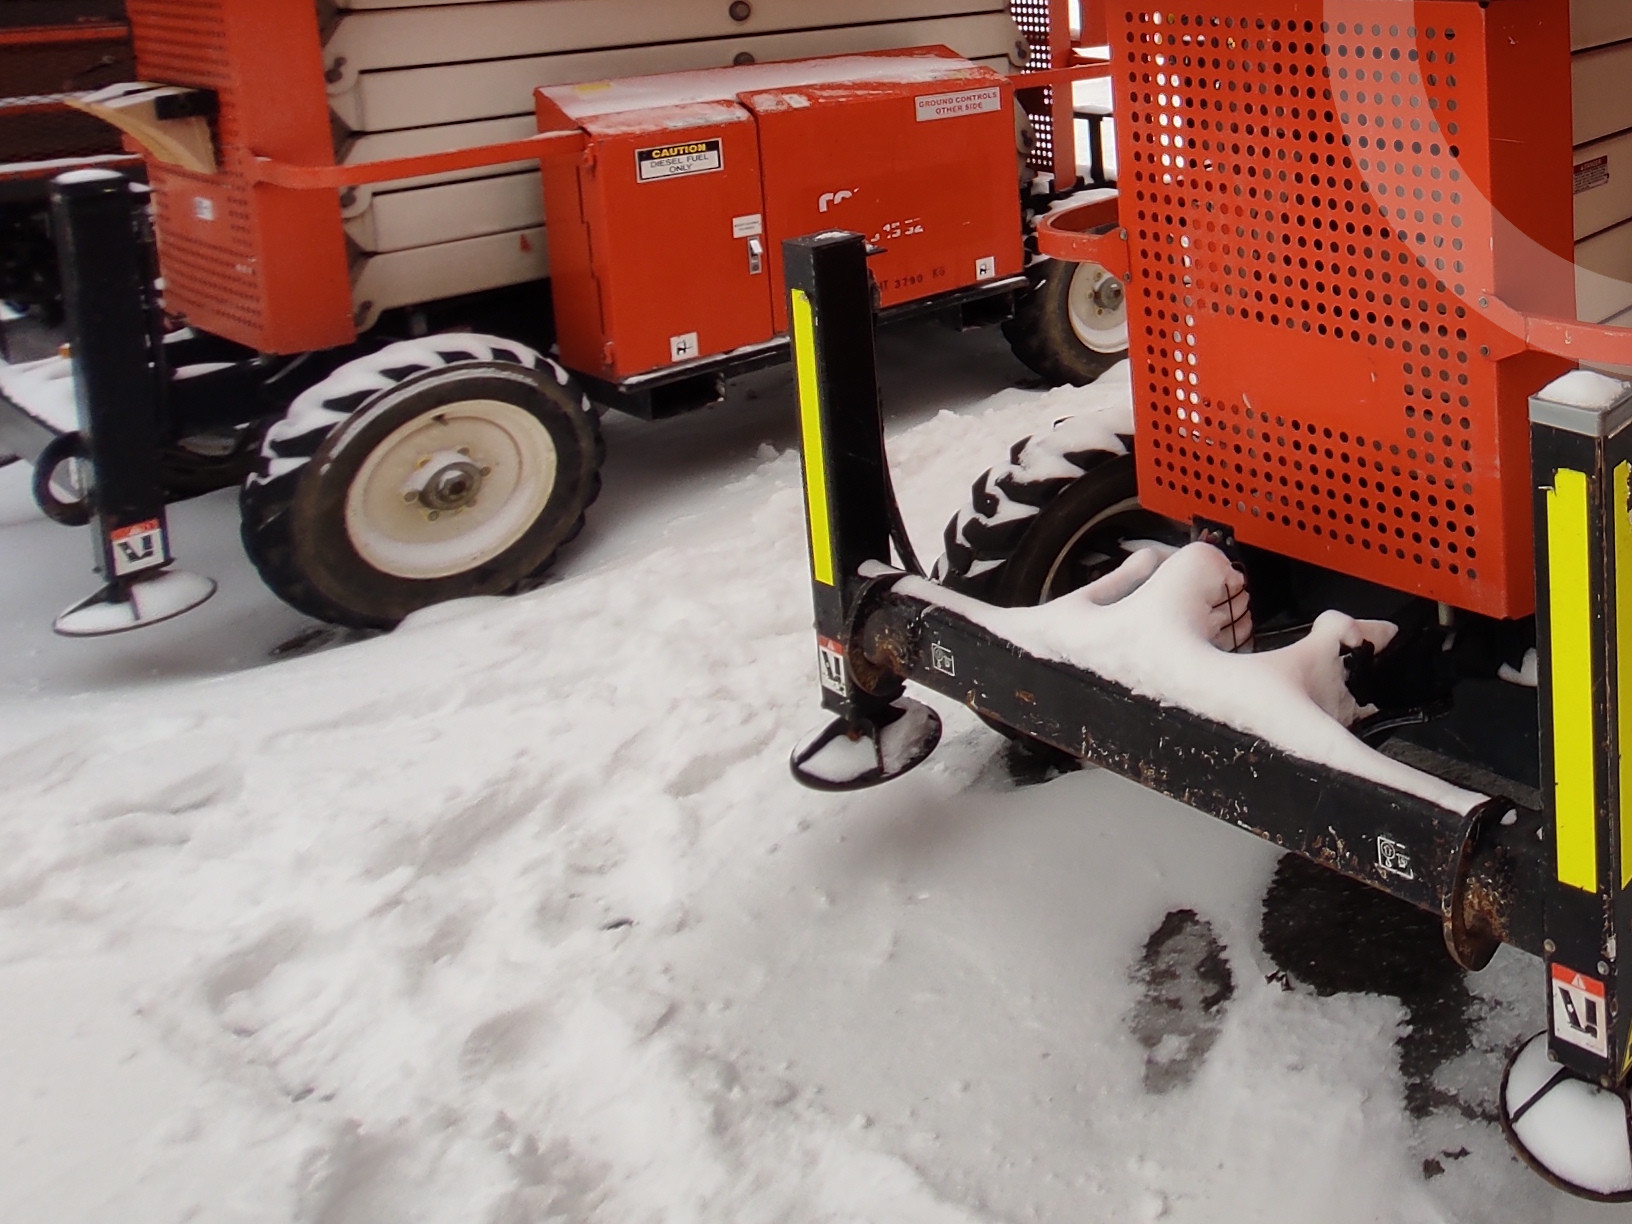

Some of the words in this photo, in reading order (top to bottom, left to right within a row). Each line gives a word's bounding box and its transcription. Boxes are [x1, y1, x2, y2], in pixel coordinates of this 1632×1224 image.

[918, 97, 954, 108] GROUND
[955, 91, 998, 104] CONTROLS
[935, 104, 963, 115] OTHER
[965, 102, 983, 112] SIDE
[651, 143, 707, 158] CAUTION
[650, 157, 683, 168] DIESEL
[686, 153, 709, 163] FUEL
[669, 163, 693, 173] ONLY
